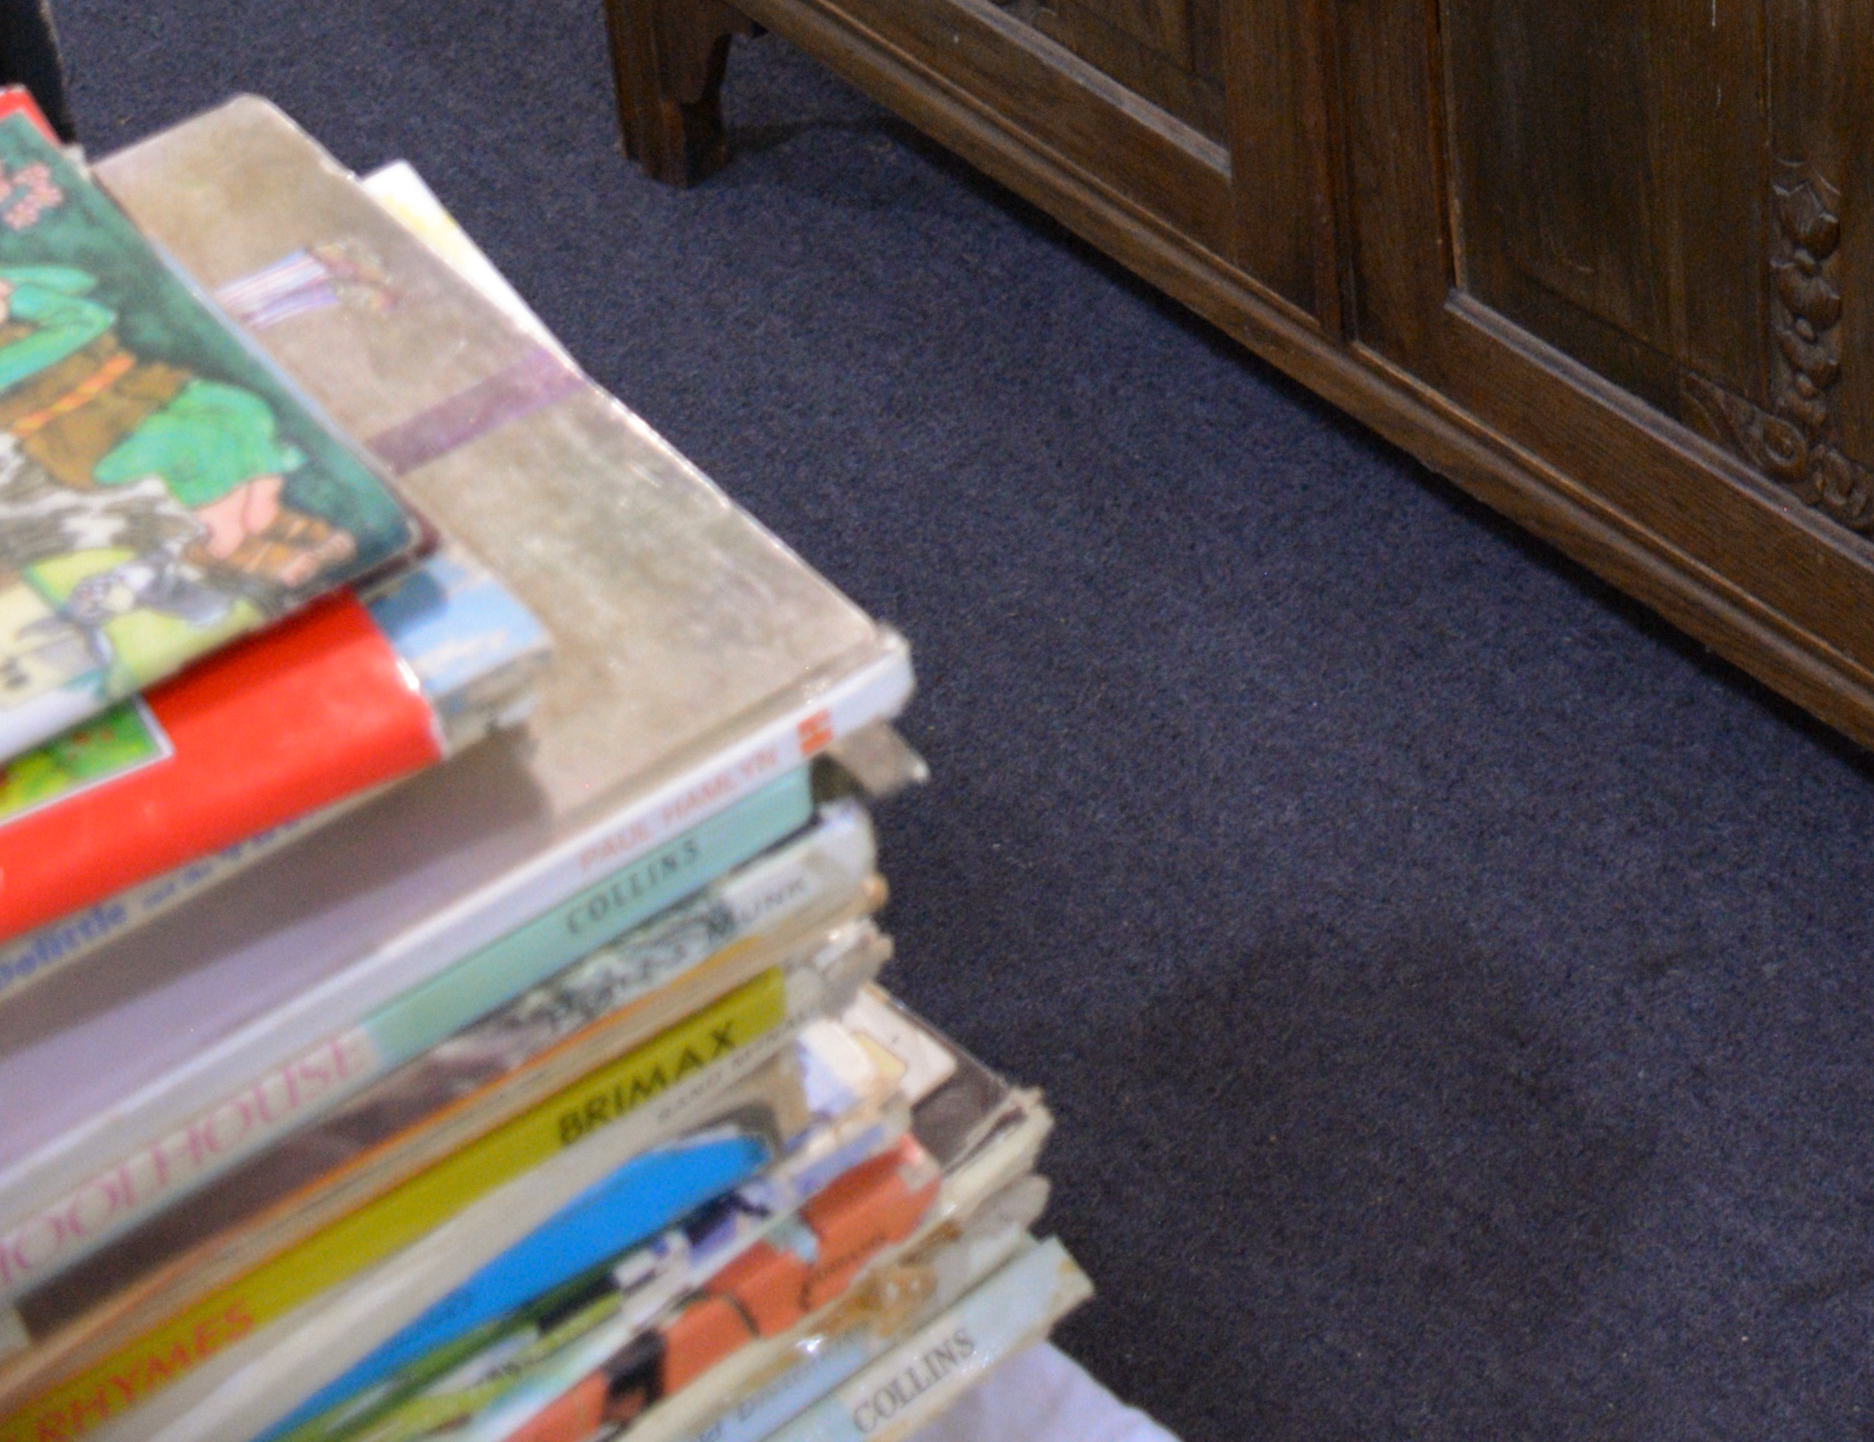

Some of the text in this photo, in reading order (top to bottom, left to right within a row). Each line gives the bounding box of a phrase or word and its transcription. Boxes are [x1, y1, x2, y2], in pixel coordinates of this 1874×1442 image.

[565, 837, 700, 935] COLLINS
[557, 1021, 736, 1147] BRIMAX
[851, 1328, 977, 1434] COLLINS
